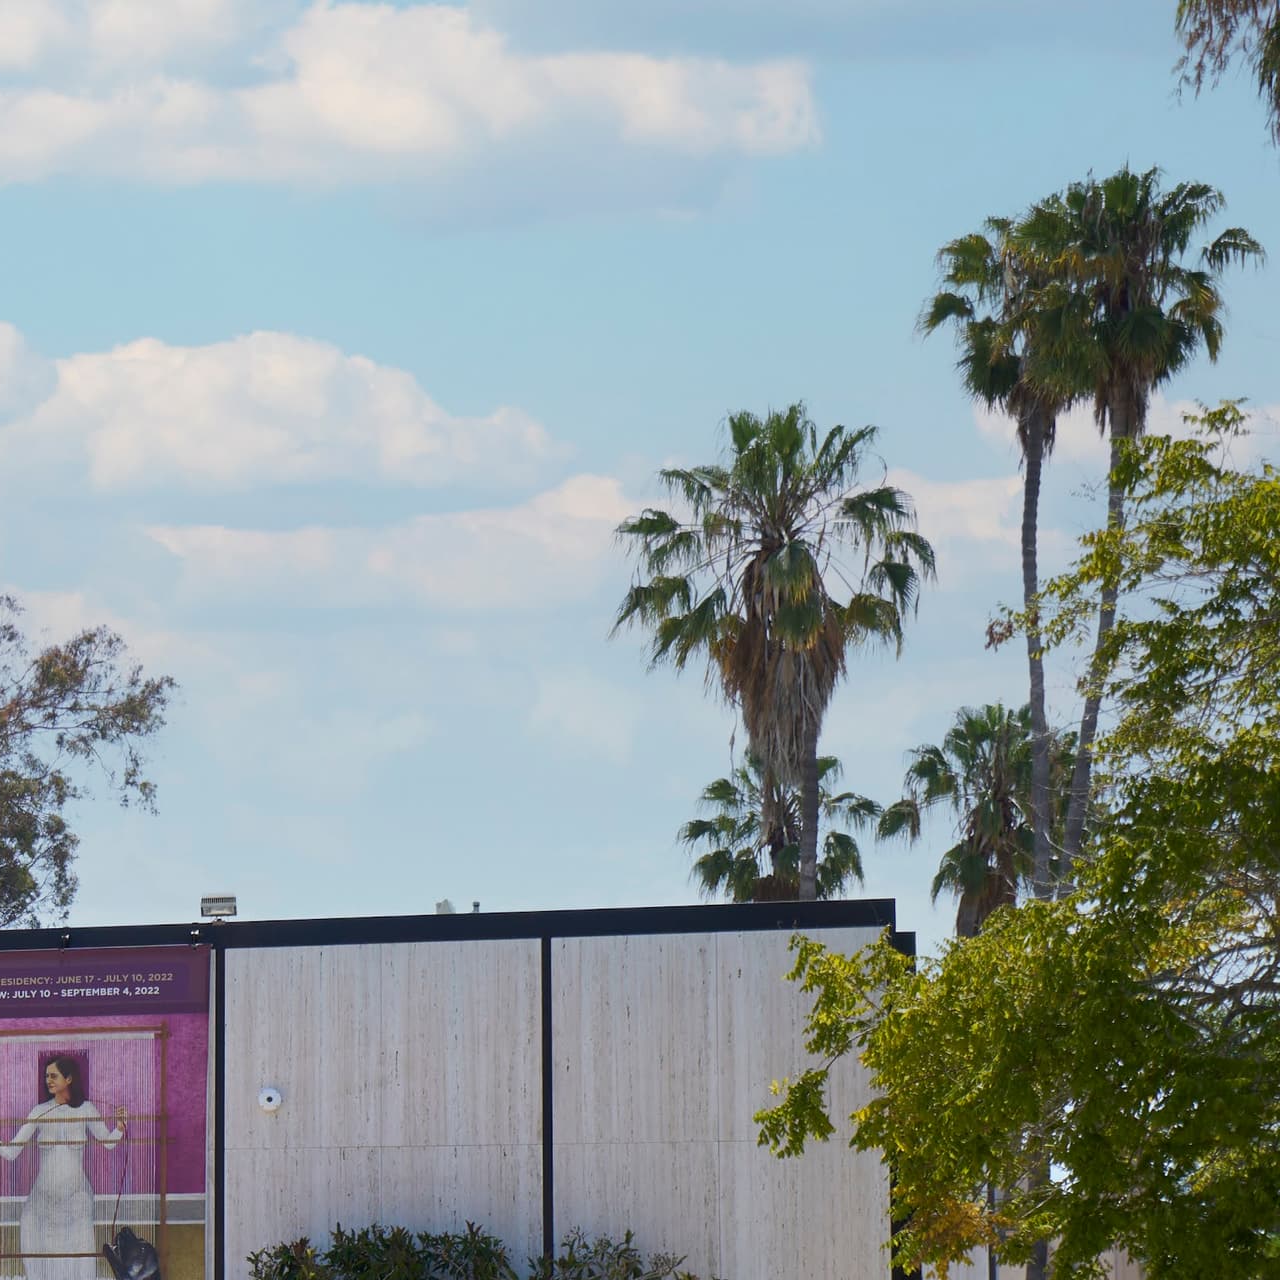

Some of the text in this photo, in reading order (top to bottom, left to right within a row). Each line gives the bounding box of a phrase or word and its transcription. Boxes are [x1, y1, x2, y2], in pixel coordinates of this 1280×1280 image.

[55, 975, 82, 985] JUNE
[84, 975, 95, 984] 17
[103, 974, 129, 983] JULY
[131, 973, 146, 984] 10,
[148, 973, 174, 982] 2022
[12, 990, 38, 999] JULY
[39, 989, 51, 998] 10
[61, 987, 120, 997] SEPTEMBER
[122, 987, 133, 997] 4,
[134, 986, 160, 995] 2022
